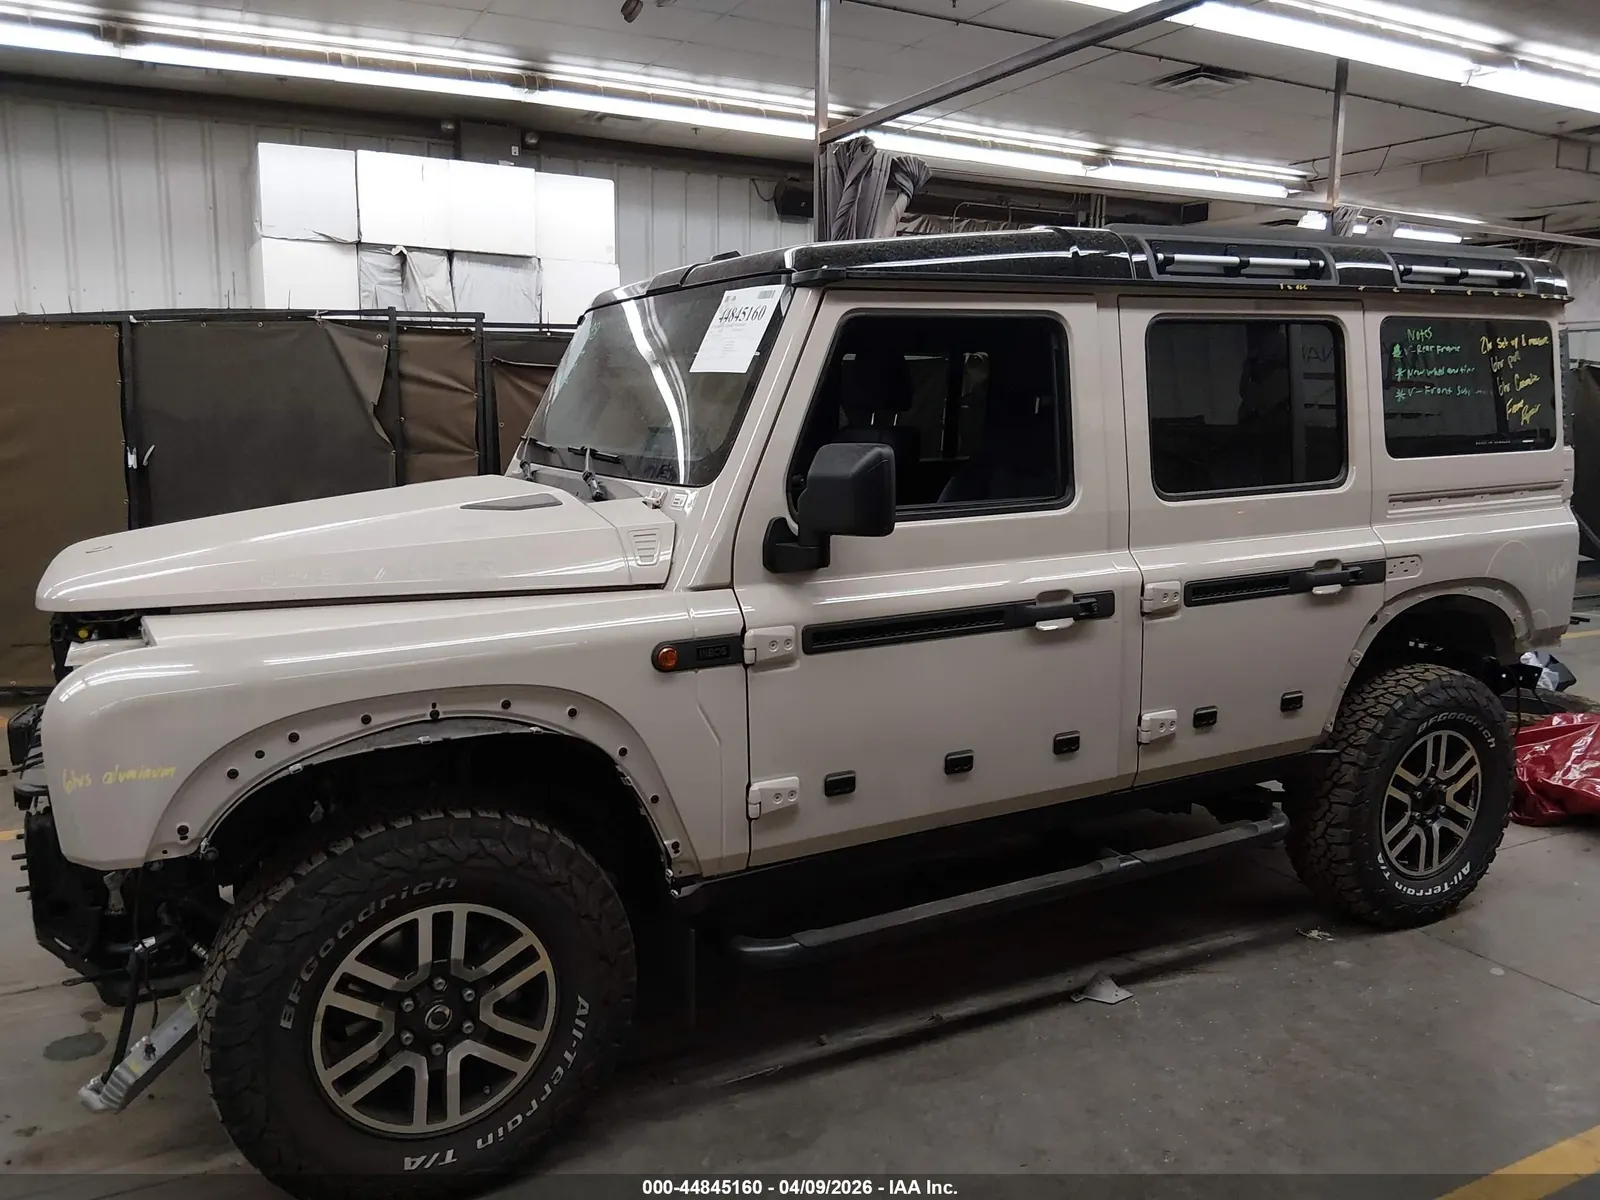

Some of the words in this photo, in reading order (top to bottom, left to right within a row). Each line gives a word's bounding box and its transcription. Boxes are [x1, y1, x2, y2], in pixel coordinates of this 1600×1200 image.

[719, 304, 767, 323] 44845160
[1416, 711, 1496, 749] BFGoodrich
[1394, 861, 1471, 897] All-Terrain
[279, 875, 459, 1030] BFGoodrich
[475, 993, 592, 1151] All-Terrain
[402, 1146, 458, 1172] T/A
